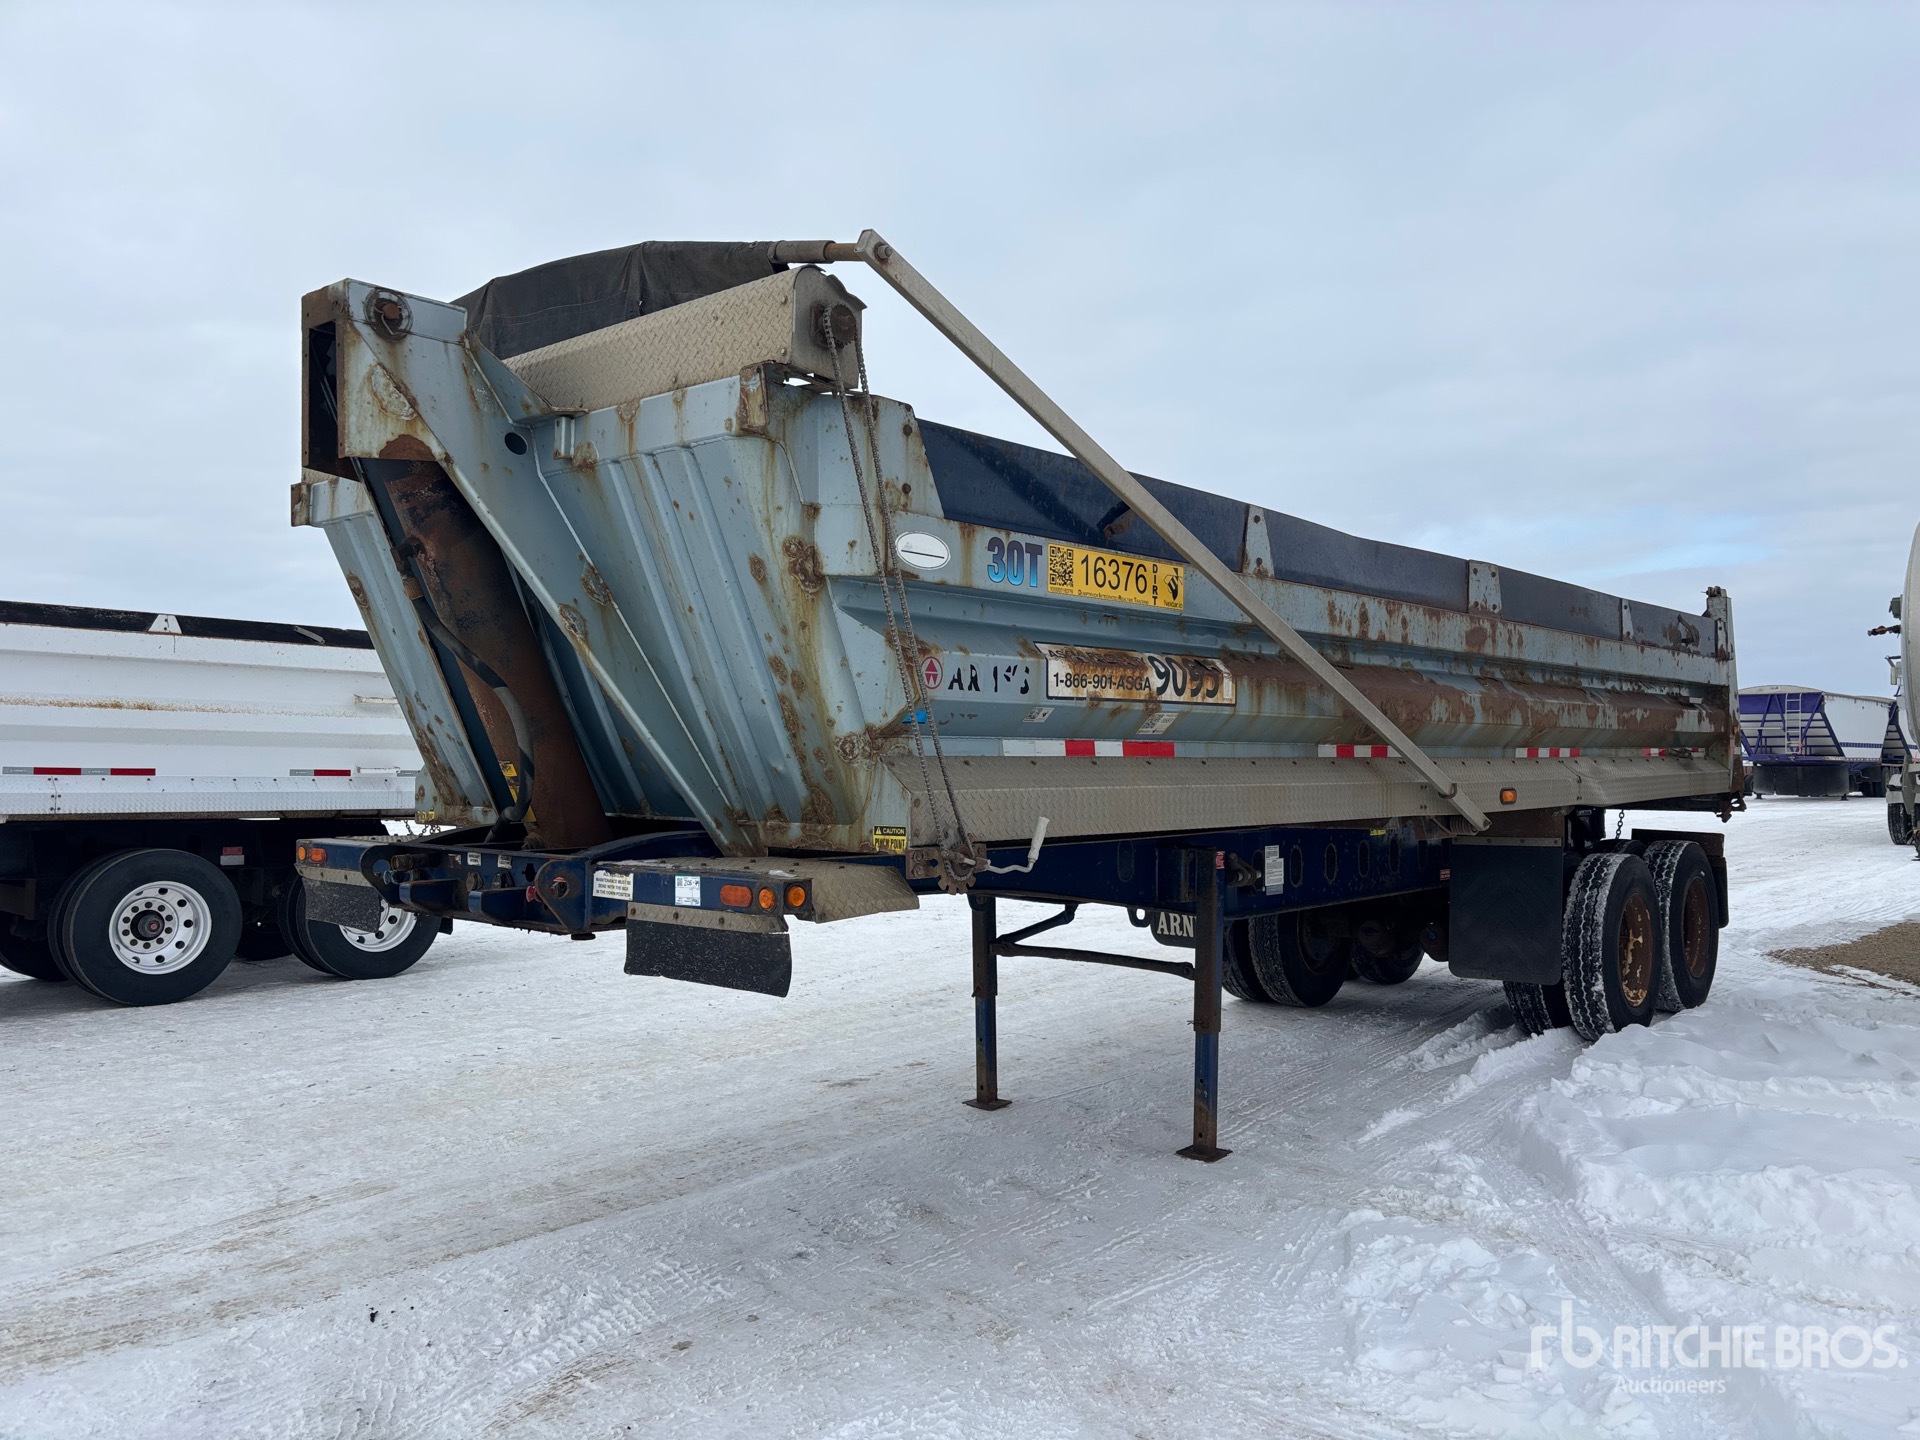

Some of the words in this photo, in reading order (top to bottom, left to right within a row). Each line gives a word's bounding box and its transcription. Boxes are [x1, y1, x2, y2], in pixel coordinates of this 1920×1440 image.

[987, 536, 1043, 588] 30T
[1080, 554, 1147, 594] 16376
[1053, 672, 1151, 691] 1-866-901-ASGA
[882, 827, 905, 835] CAUTION
[1157, 912, 1197, 937] ARN
